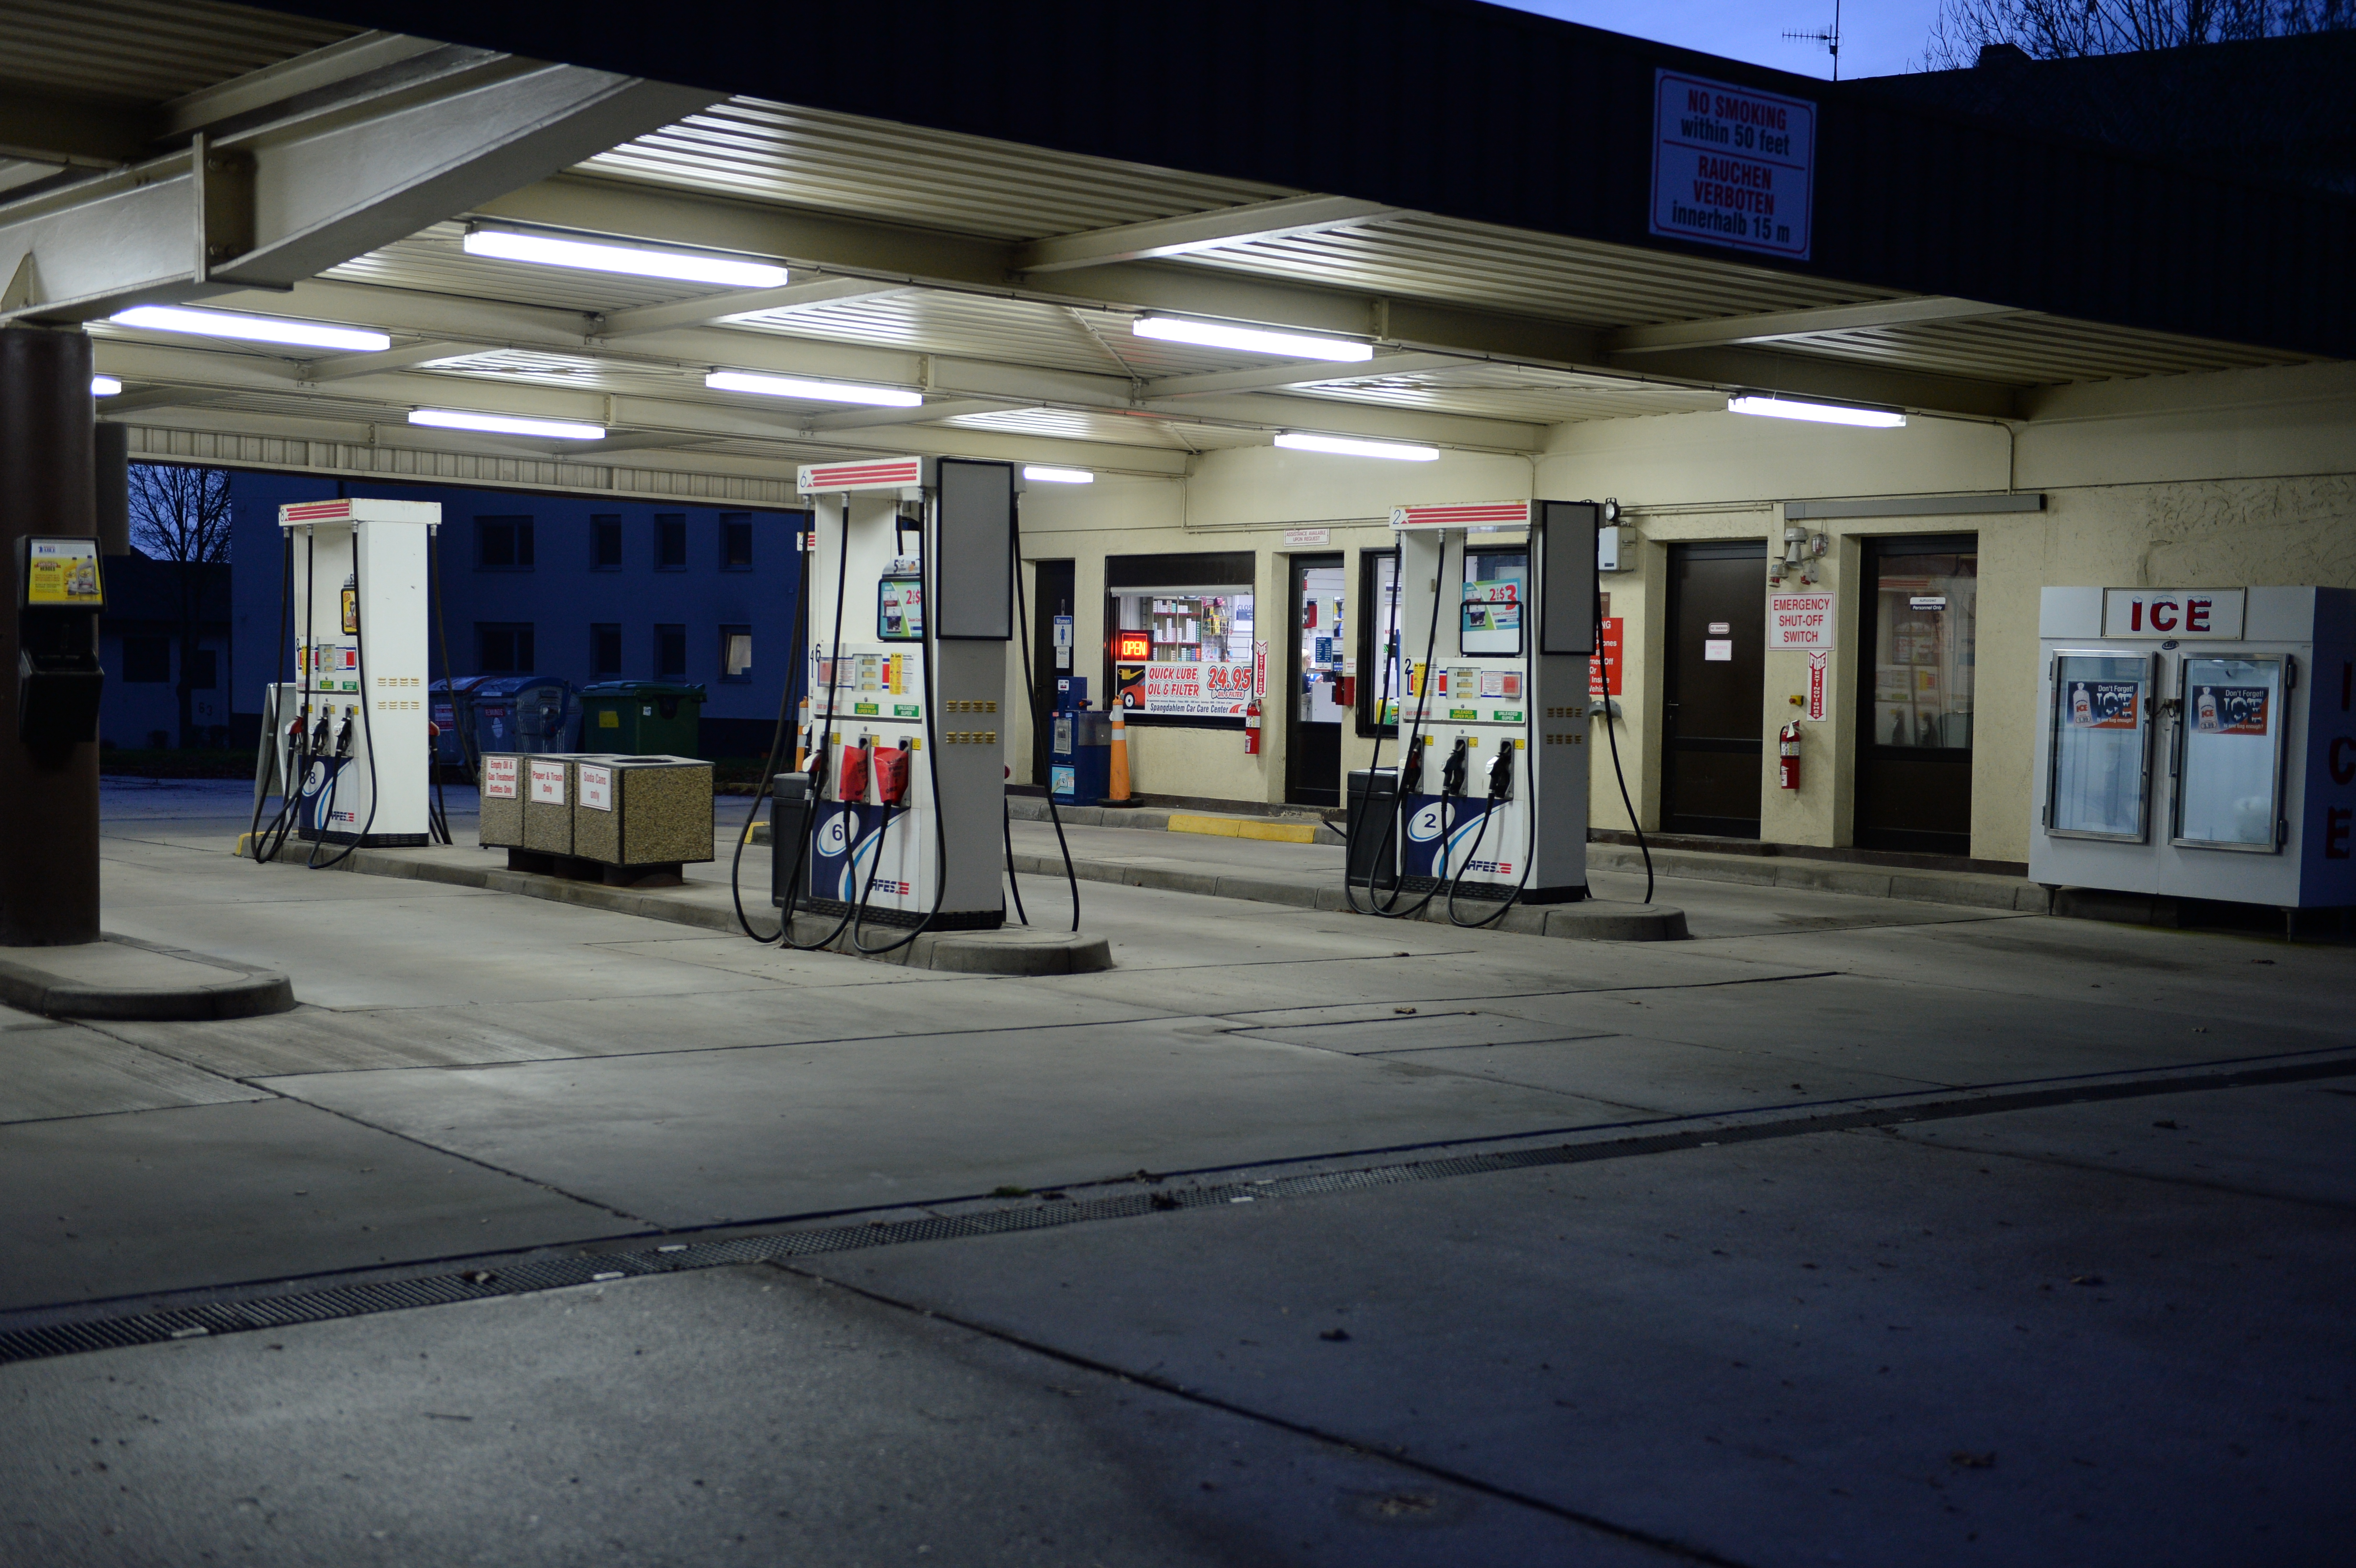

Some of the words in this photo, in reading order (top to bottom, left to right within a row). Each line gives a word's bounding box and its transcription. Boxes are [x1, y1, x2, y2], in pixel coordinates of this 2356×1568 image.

[1688, 89, 1710, 113] NO
[1715, 95, 1786, 130] SMOKING
[1681, 116, 1729, 143] within
[1735, 124, 1754, 148] 50
[1759, 129, 1789, 156] feet
[1699, 156, 1772, 189] RAUCHEN
[1694, 181, 1774, 215] VERBOTEN
[1672, 201, 1747, 235] innerhalb
[1753, 217, 1771, 239] 15
[1777, 225, 1789, 243] m
[800, 470, 807, 488] 6
[280, 509, 284, 522] 8
[1393, 509, 1401, 524] 2
[906, 589, 912, 604] 2
[1490, 588, 1496, 601] 2
[1774, 599, 1830, 610] EMERGENCY
[1779, 615, 1823, 626] SHUT-OFF
[2131, 595, 2212, 632] ICE
[1784, 631, 1818, 642] SWITCH
[816, 643, 821, 663] 6
[1123, 641, 1146, 655] OPEN
[1256, 644, 1267, 656] FIRE
[1405, 658, 1411, 674] 2
[1810, 654, 1825, 670] FIRE
[1149, 667, 1175, 680] QUICK
[1176, 668, 1199, 682] LUBE,
[1208, 667, 1252, 690] 24.95
[1148, 683, 1161, 696] OIL
[1163, 683, 1168, 695] &
[1171, 683, 1200, 697] FILTER
[2243, 690, 2263, 698] Forget!
[1150, 703, 1185, 714] Spangdahlem
[1186, 704, 1195, 712] Car
[1211, 705, 1229, 713] Center
[2076, 704, 2088, 712] ICE
[2096, 692, 2132, 717] ICE
[2224, 697, 2262, 723] ICE
[2202, 709, 2214, 718] ICE
[491, 760, 502, 770] Empty
[510, 761, 513, 769] &
[309, 772, 316, 784] 8
[496, 773, 515, 782] Treatment
[533, 771, 545, 781] Paper
[546, 772, 549, 780] &
[551, 772, 563, 782] Trash
[584, 772, 594, 783] Soda
[596, 773, 606, 785] Cans
[490, 784, 502, 793] Bottles
[504, 785, 513, 795] Only
[543, 784, 552, 795] Only
[590, 790, 600, 802] only
[331, 811, 347, 821] AFES
[1424, 813, 1436, 828] 2
[832, 824, 843, 846] 6
[1466, 860, 1497, 872] AFES
[872, 879, 896, 897] AFES
